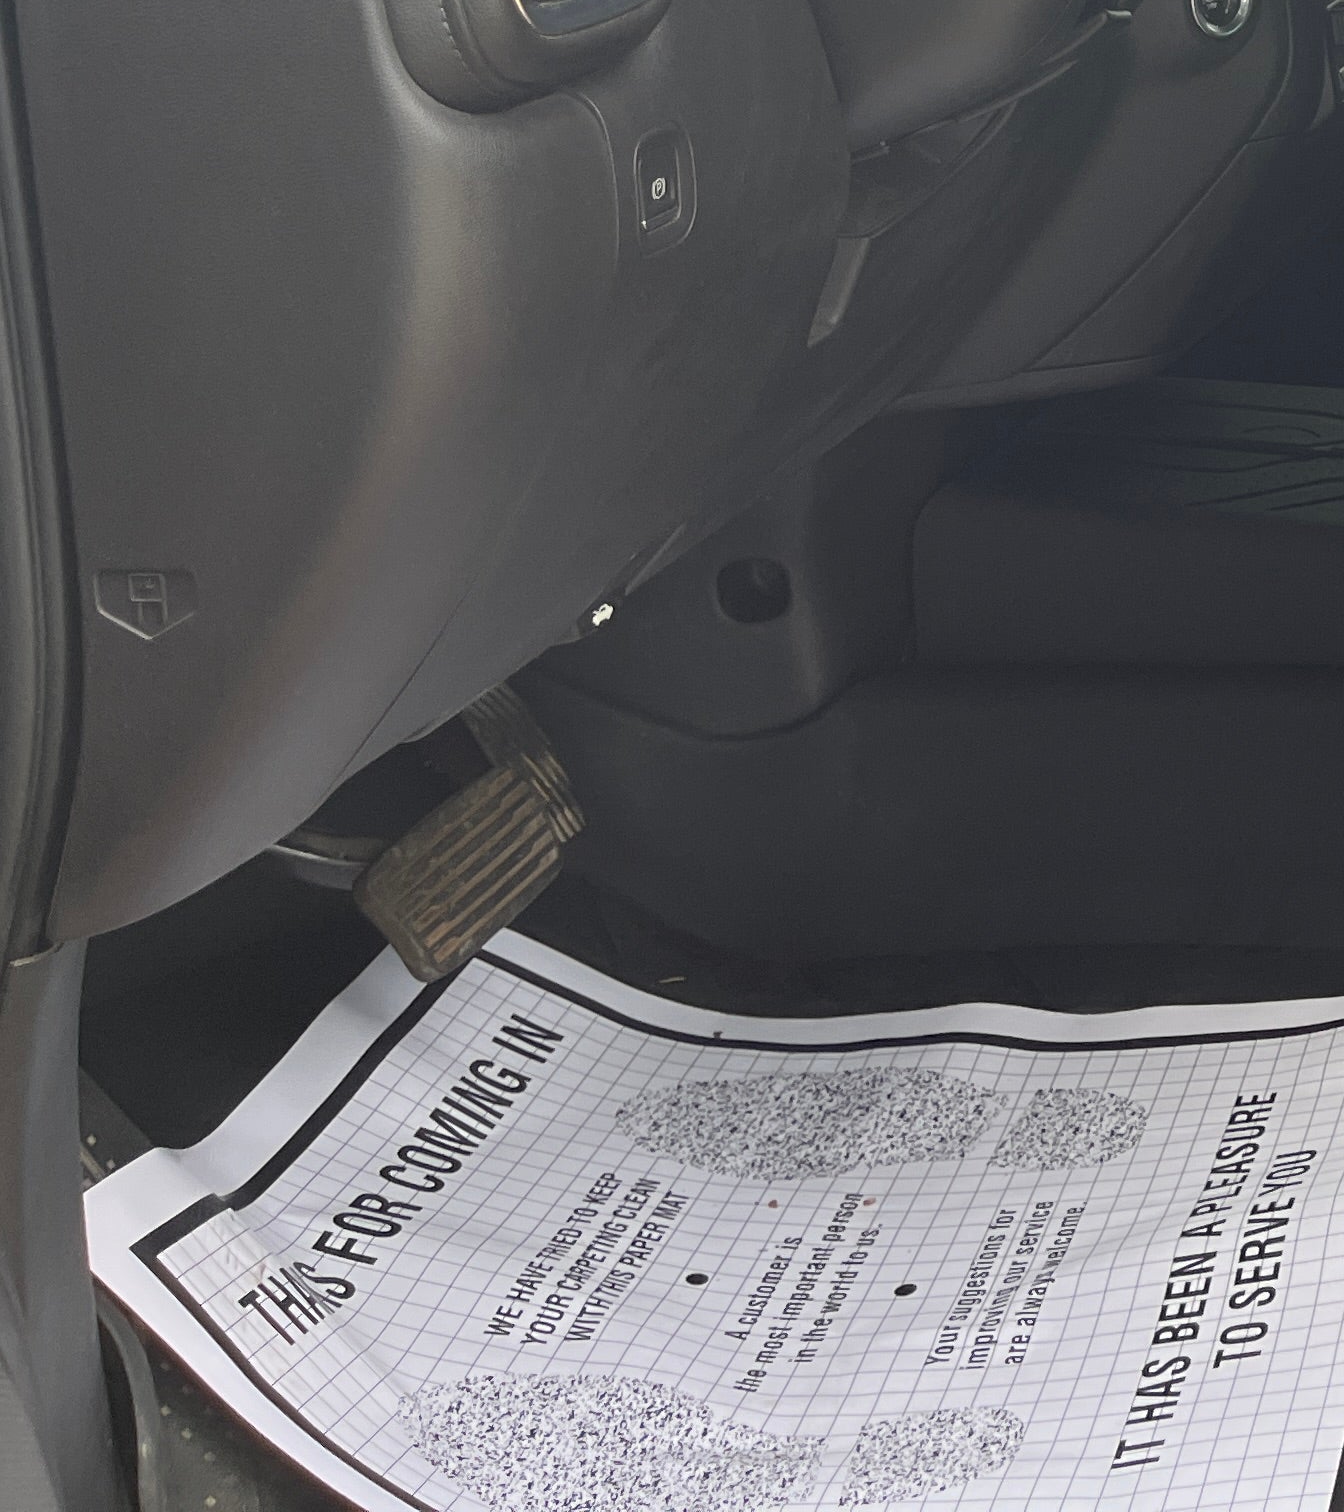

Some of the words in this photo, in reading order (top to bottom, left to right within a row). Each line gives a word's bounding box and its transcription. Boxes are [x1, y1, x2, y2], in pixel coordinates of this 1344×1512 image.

[312, 1193, 423, 1265] FOR
[379, 1059, 531, 1193] COMING
[492, 1013, 564, 1064] IN
[1189, 1092, 1277, 1214] PLEASURE
[1258, 1149, 1318, 1197] YOU
[822, 1192, 864, 1243] person
[857, 1223, 882, 1247] us.
[1003, 1260, 1028, 1284] our
[1016, 1201, 1054, 1254] service
[1181, 1217, 1227, 1239] A
[484, 1305, 523, 1336] WE
[506, 1261, 553, 1302] HAVE
[536, 1228, 582, 1261] TRIED
[567, 1207, 598, 1224] TO
[583, 1173, 622, 1205] KEEP
[520, 1294, 573, 1345] YOUR
[557, 1221, 628, 1290] CARPETING
[613, 1178, 660, 1220] CLEAN
[564, 1295, 610, 1342] WITH
[596, 1268, 635, 1298] THIS
[620, 1222, 669, 1269] PAPER
[653, 1190, 690, 1220] MAT
[841, 1250, 868, 1265] to
[1228, 1197, 1296, 1309] SERVE
[725, 1329, 750, 1341] A
[739, 1255, 792, 1325] customer
[775, 1236, 802, 1250] is
[773, 1247, 835, 1321] important
[821, 1271, 859, 1313] world
[924, 1326, 960, 1366] Your
[949, 1234, 1006, 1321] suggestions
[989, 1209, 1017, 1230] for
[1151, 1250, 1218, 1346] BEEN
[755, 1326, 792, 1365] most
[788, 1348, 816, 1364] in
[800, 1318, 833, 1343] the
[1004, 1334, 1031, 1365] are
[1212, 1321, 1269, 1368] TO
[733, 1368, 767, 1393] the
[1125, 1354, 1191, 1425] HAS
[1111, 1439, 1165, 1470] IT
